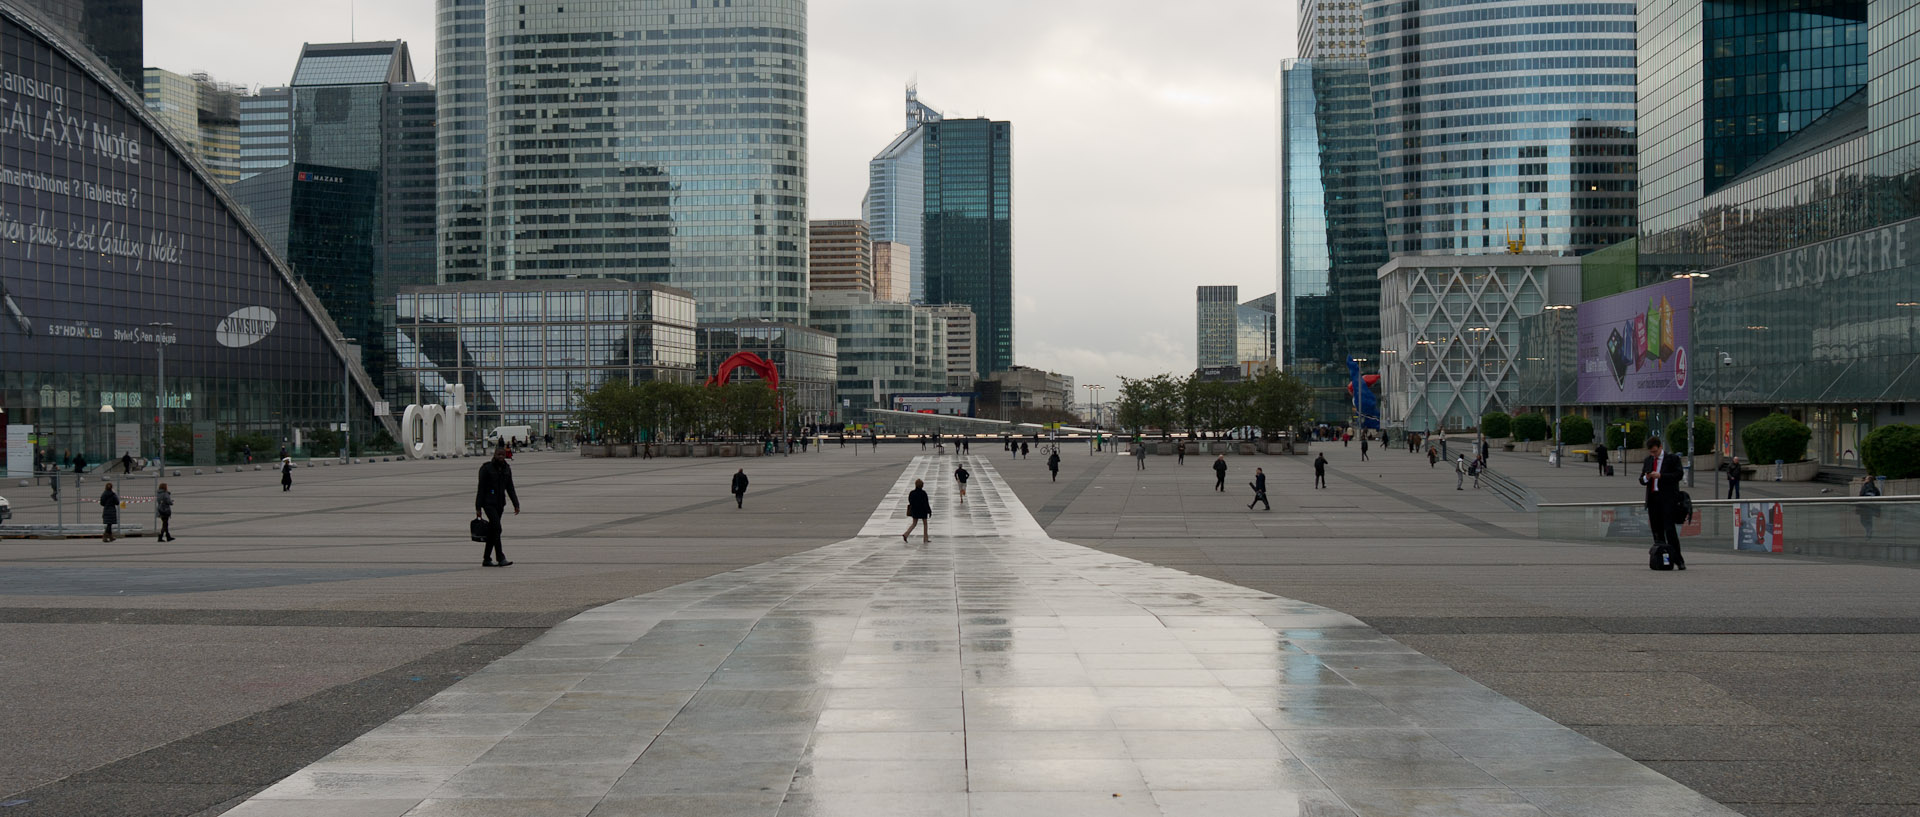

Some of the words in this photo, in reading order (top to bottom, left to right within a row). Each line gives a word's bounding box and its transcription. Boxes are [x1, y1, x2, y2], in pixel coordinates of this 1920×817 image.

[0, 63, 63, 112] amsung
[93, 122, 140, 164] Note
[73, 180, 80, 197] ?
[83, 181, 128, 206] Tablette
[130, 188, 138, 208] ?
[313, 175, 344, 183] MAZARS
[0, 206, 25, 241] ien
[27, 210, 63, 259] plus,
[100, 221, 143, 271] Galaxy
[224, 317, 271, 335] SAMSUNG
